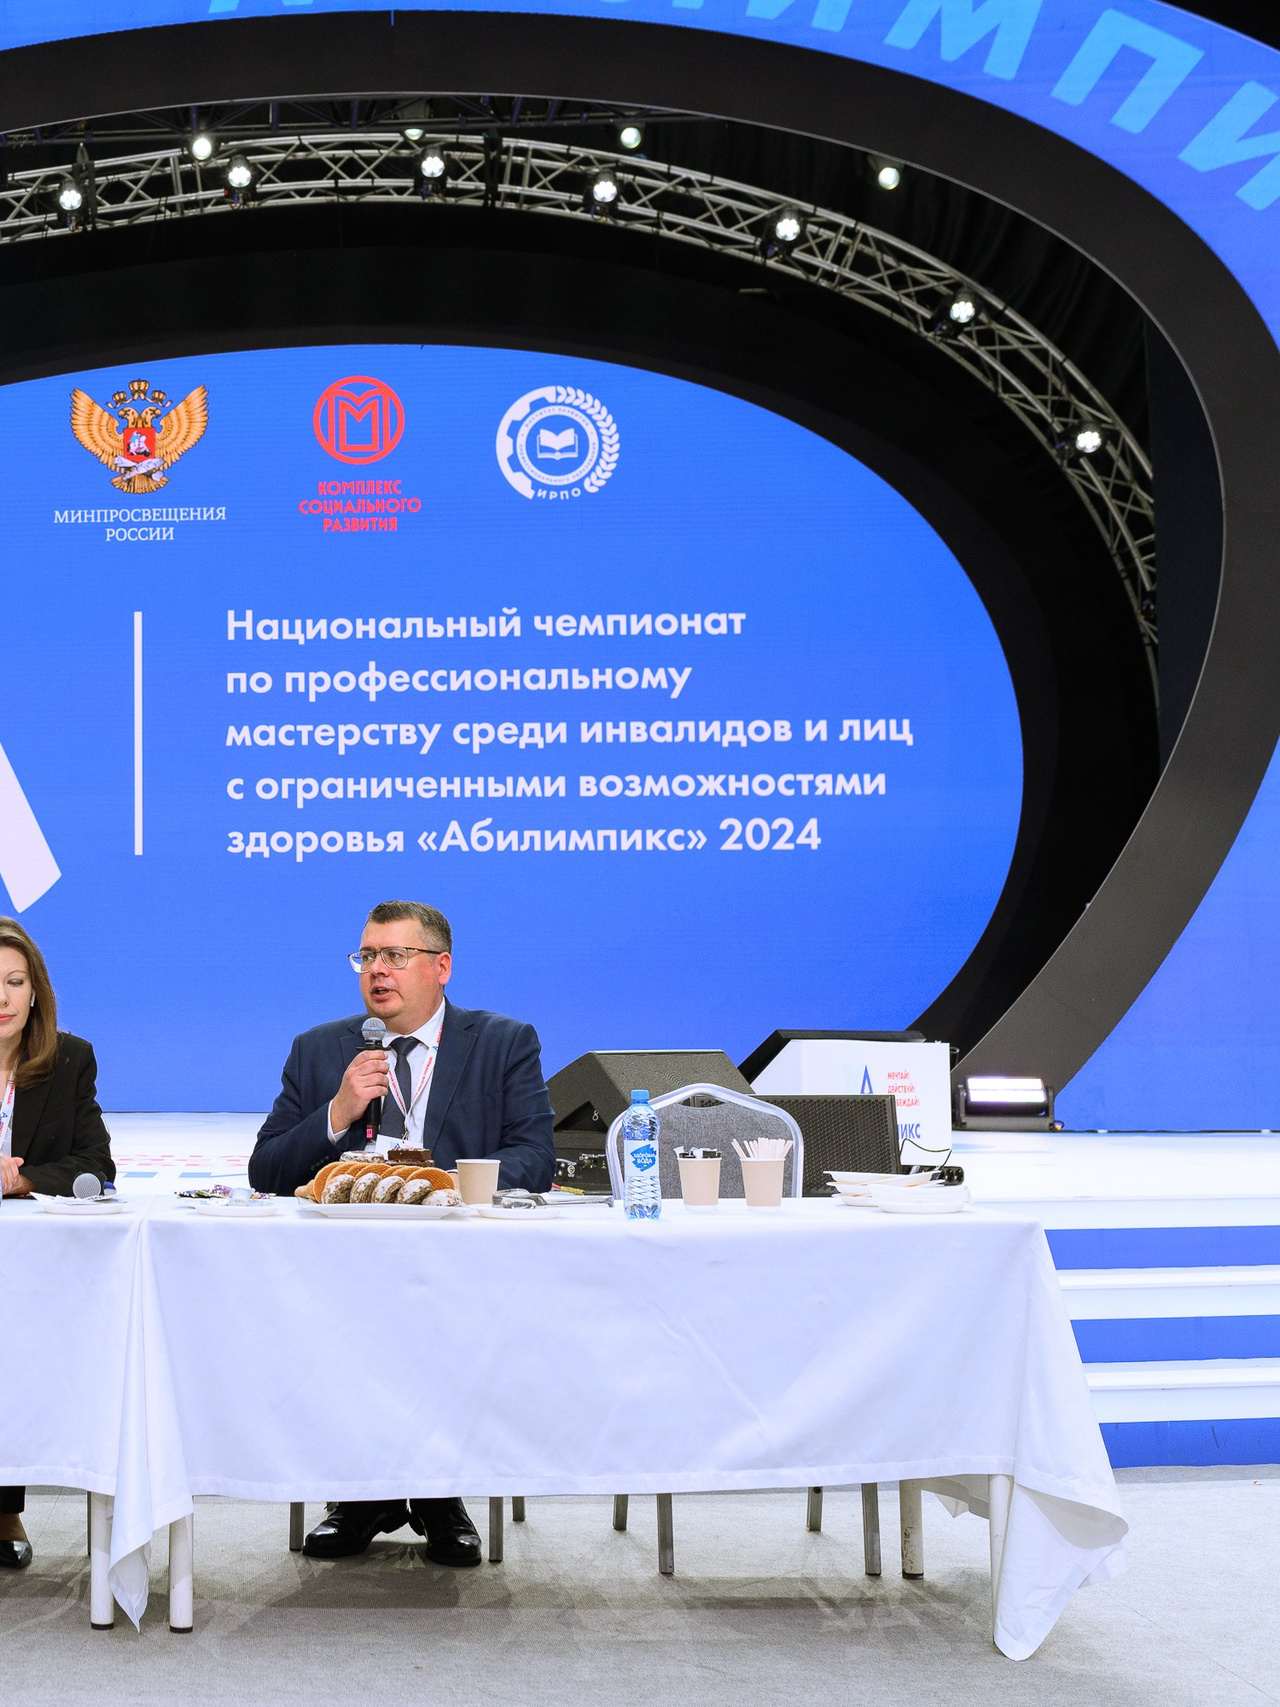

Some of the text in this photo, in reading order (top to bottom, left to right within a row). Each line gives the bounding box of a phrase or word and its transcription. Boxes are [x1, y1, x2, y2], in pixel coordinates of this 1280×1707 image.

[318, 480, 402, 496] КОМПЛЕКС
[537, 487, 581, 500] ИРПО
[54, 506, 226, 524] МИНПРОСВЕЩЕНИЯ
[298, 498, 422, 516] СОЦИАЛЬНОГО
[323, 516, 398, 532] РАЗВИТИЯ
[105, 527, 175, 542] РОССИИ
[227, 607, 747, 645] Национальный чемпионат
[226, 660, 693, 703] по профессиональному
[225, 718, 914, 756] мастерству среди инвалидов и лиц
[226, 773, 886, 809] с ограниченными возможностями
[226, 817, 822, 863] здоровья «Абилимпикс» 2024
[896, 1096, 920, 1108] БЕЖДАЙ!
